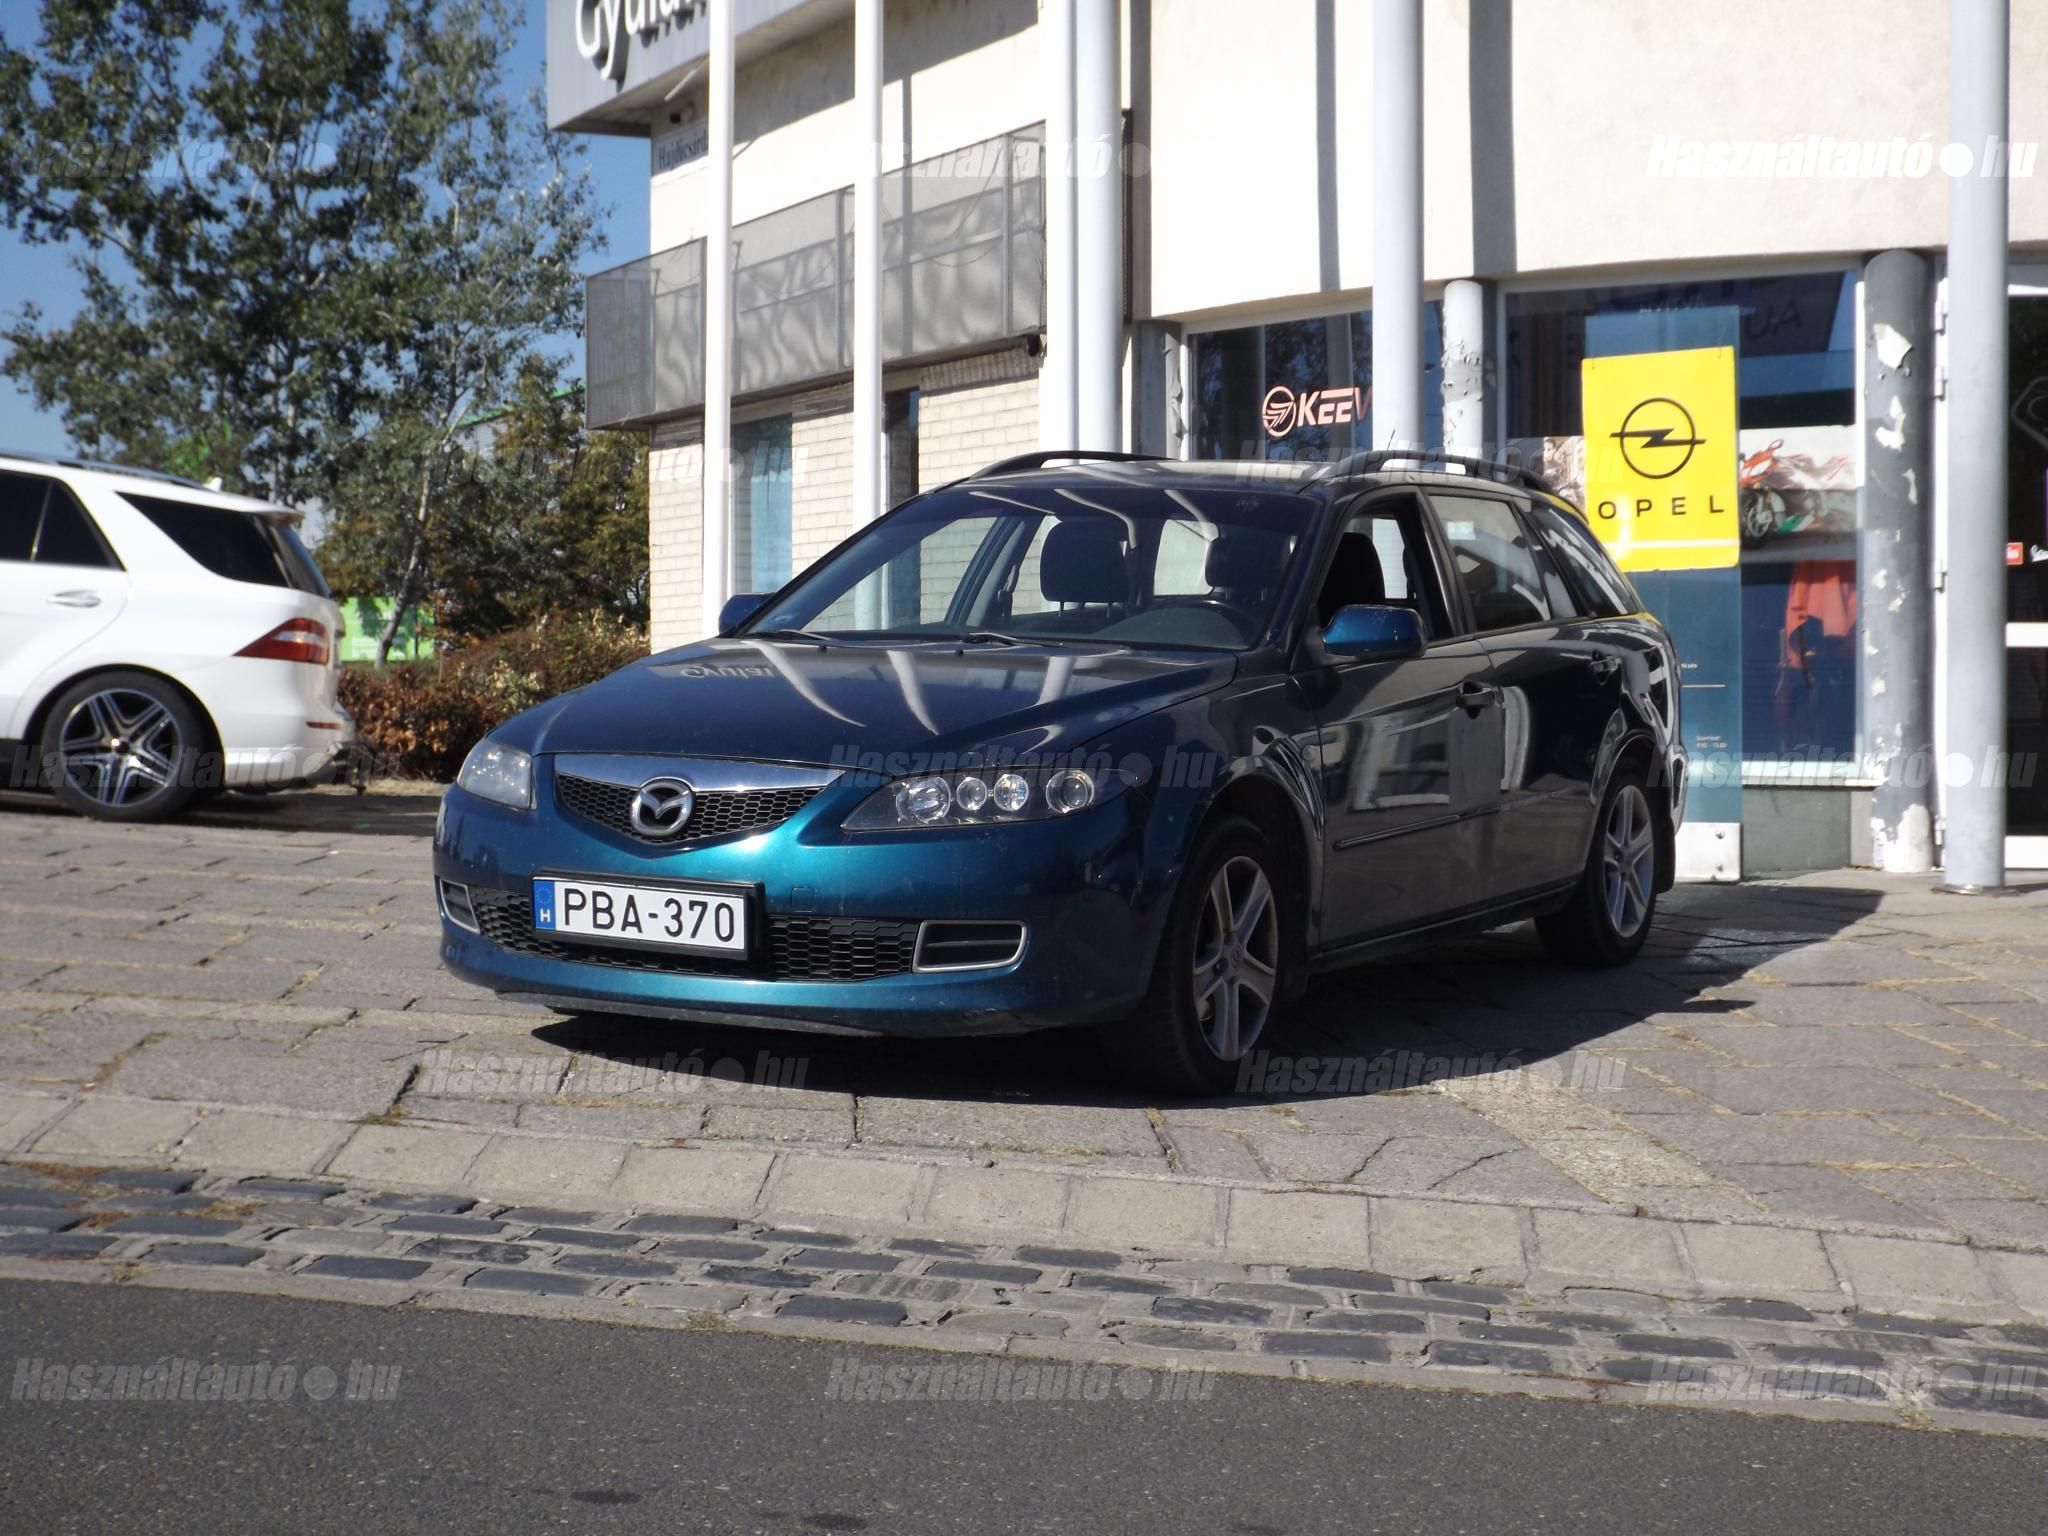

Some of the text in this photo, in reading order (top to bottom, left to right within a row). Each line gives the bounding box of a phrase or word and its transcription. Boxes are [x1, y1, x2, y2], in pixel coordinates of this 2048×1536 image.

[1598, 495, 1725, 520] OPEL
[540, 908, 551, 923] H
[563, 887, 735, 943] PBA-370
